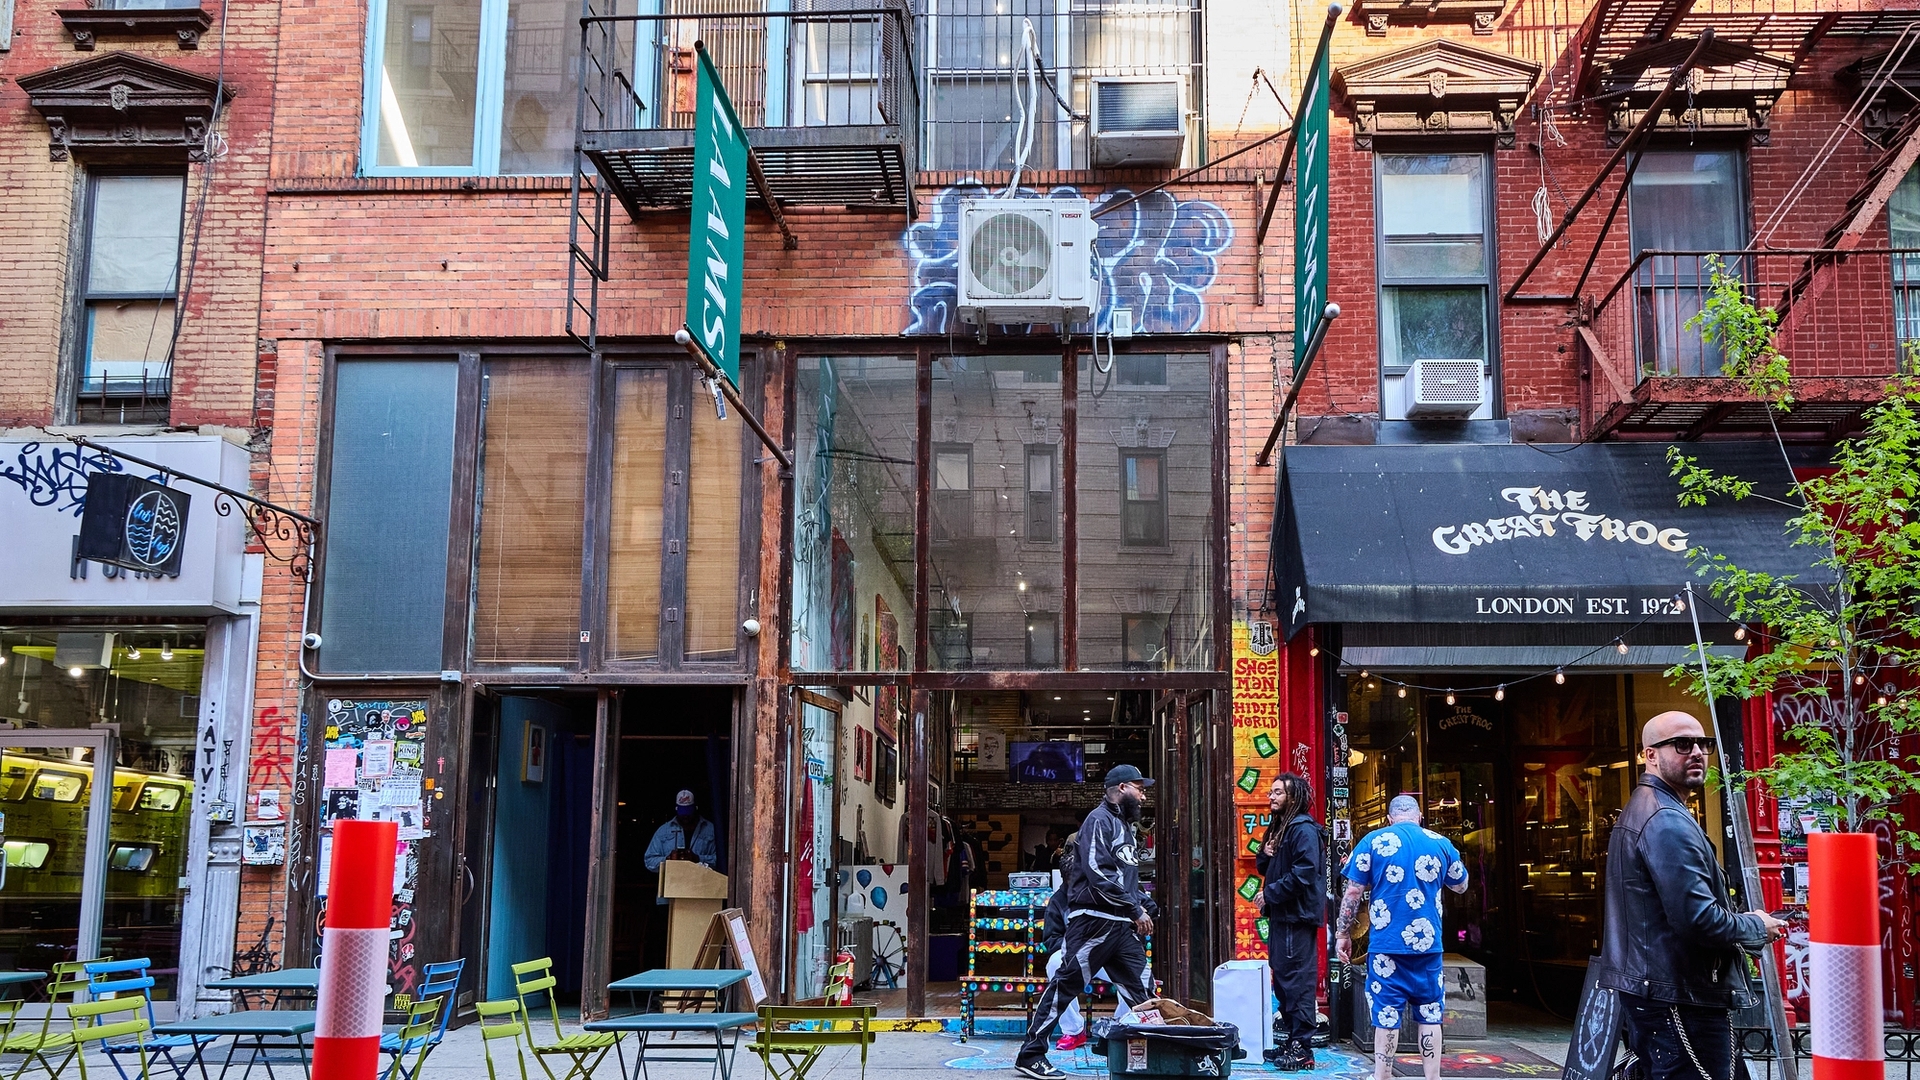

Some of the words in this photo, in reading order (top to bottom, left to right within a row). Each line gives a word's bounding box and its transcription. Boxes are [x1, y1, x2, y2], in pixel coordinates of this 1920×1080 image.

[703, 87, 733, 361] LAAMS
[1501, 485, 1590, 514] THE
[1432, 513, 1560, 555] GREAT
[1561, 512, 1690, 553] FROG
[1476, 597, 1574, 615] LONDON
[1586, 598, 1630, 615] EST.
[1641, 598, 1681, 615] 1972
[1454, 706, 1472, 714] THE
[1233, 715, 1278, 729] WORLD
[1470, 714, 1493, 731] FROG
[809, 763, 824, 778] OPEN
